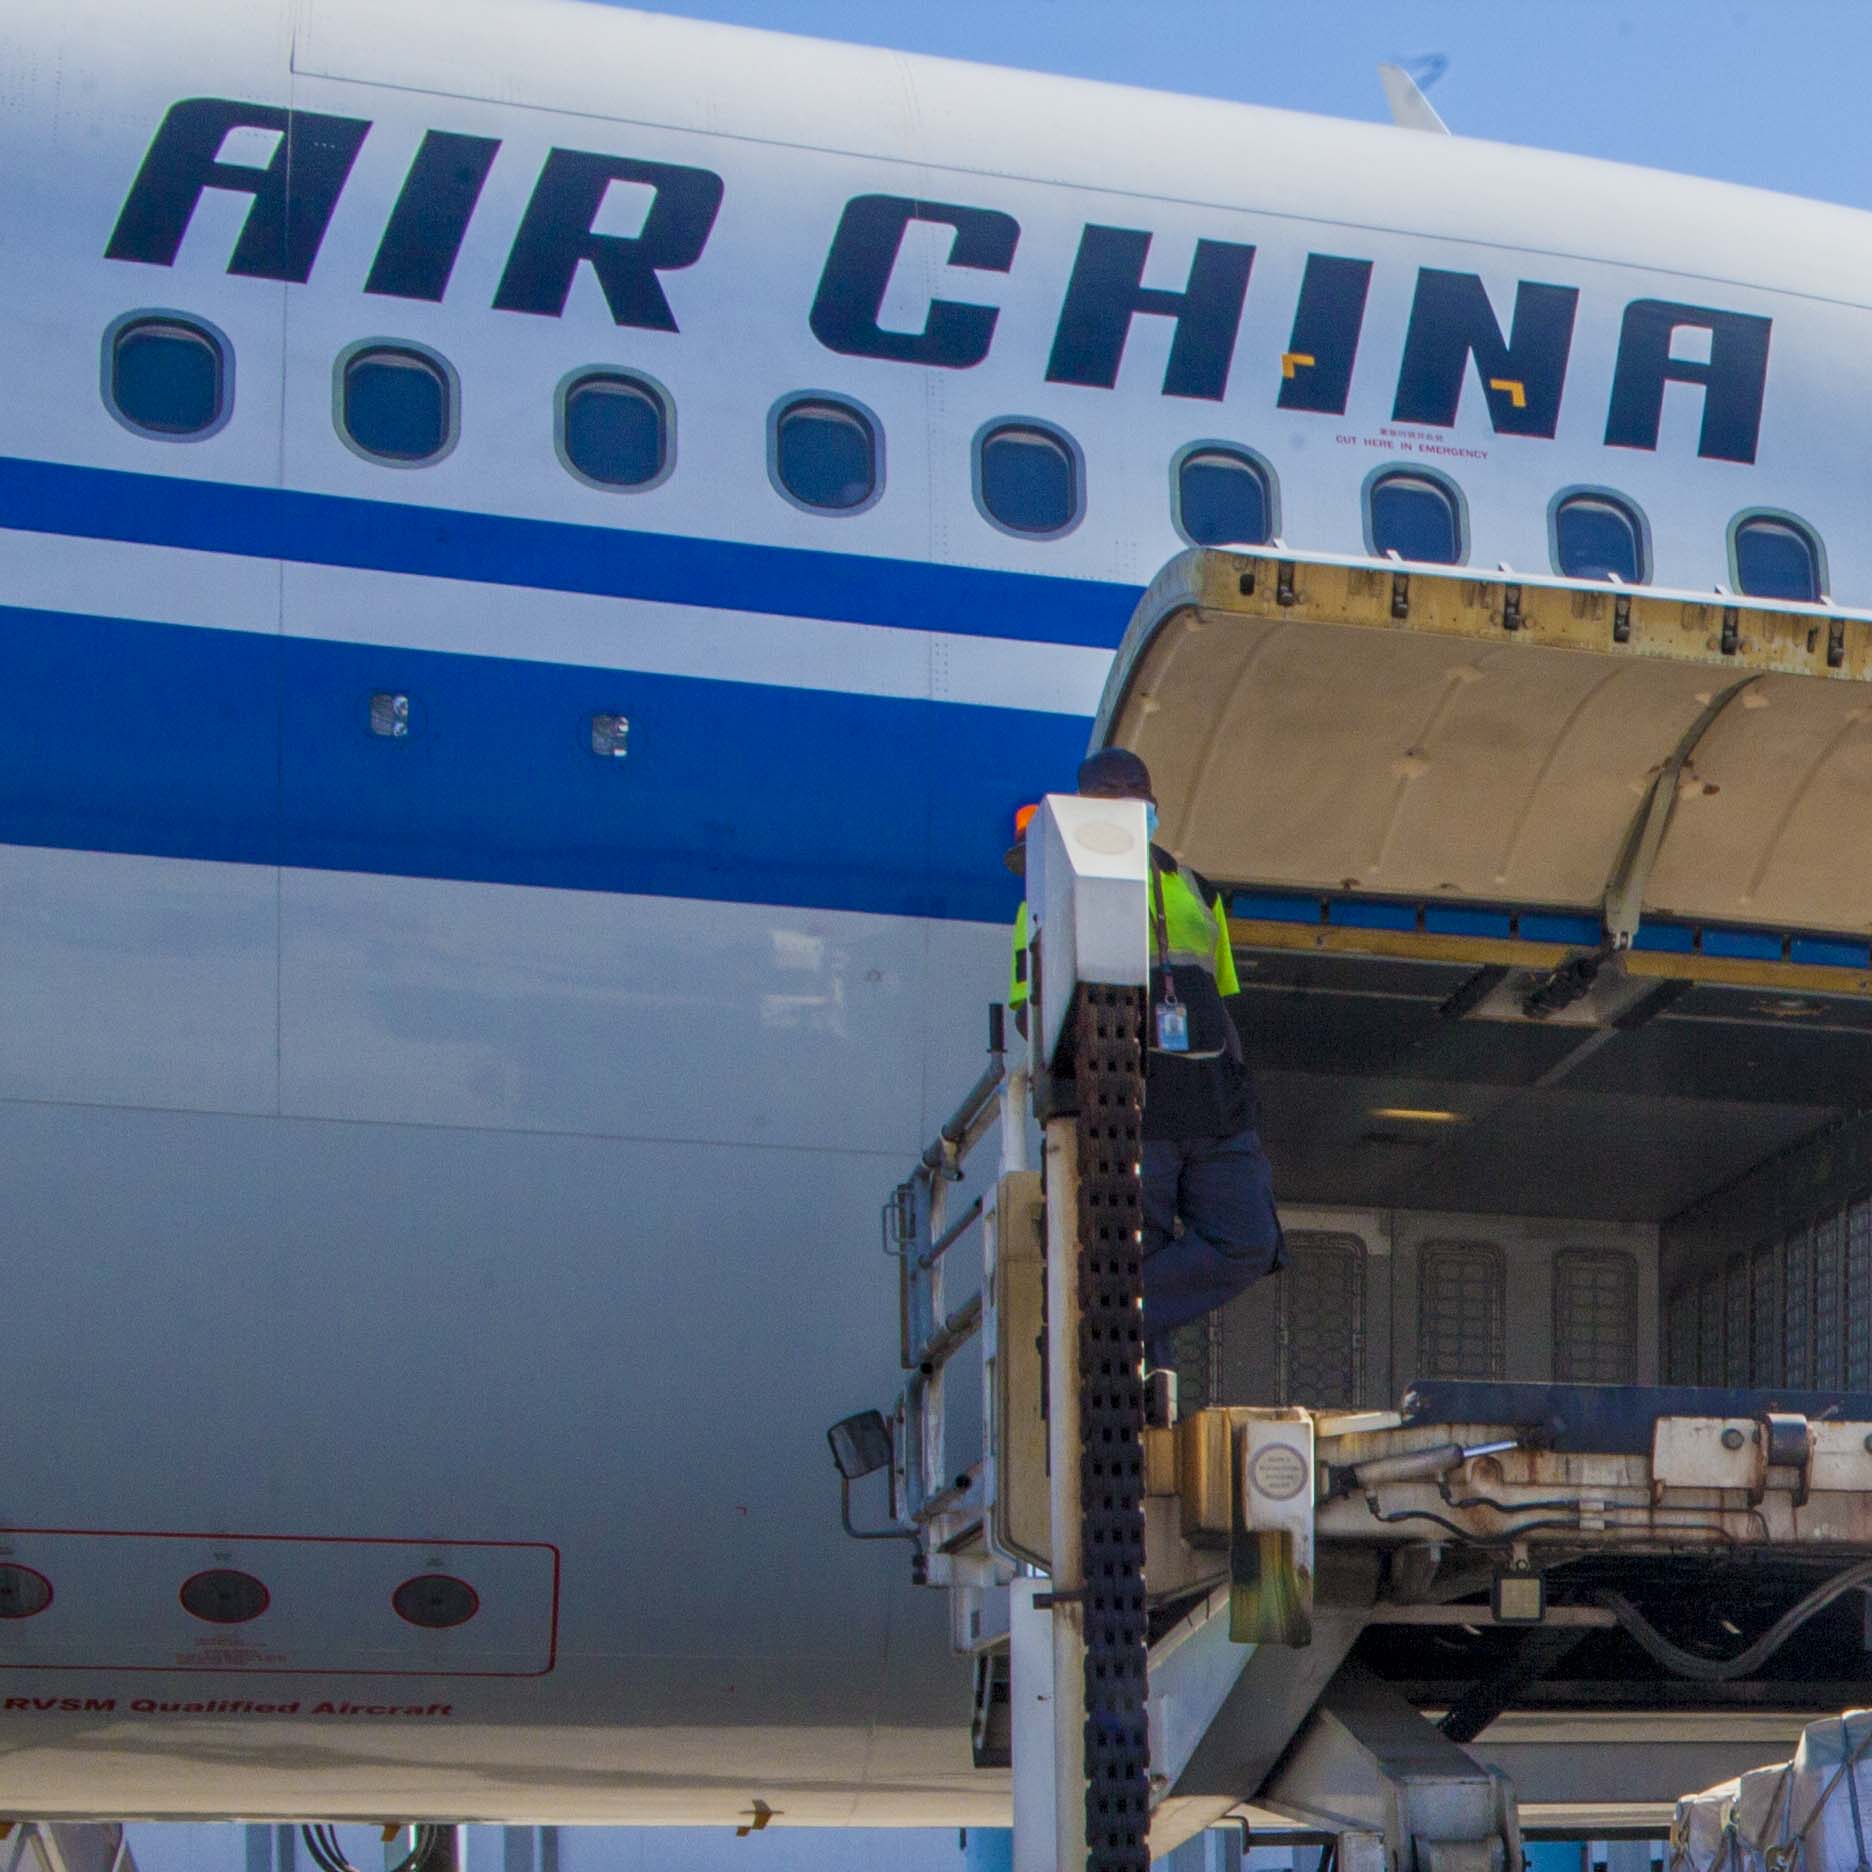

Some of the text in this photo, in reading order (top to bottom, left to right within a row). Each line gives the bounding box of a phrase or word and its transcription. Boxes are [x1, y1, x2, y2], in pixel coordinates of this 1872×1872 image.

[104, 98, 1773, 467] AIR CHINA
[1335, 434, 1489, 460] CUT HERE IN EMERGENCY
[3, 1697, 455, 1717] RVSM Qualified Aircraft
